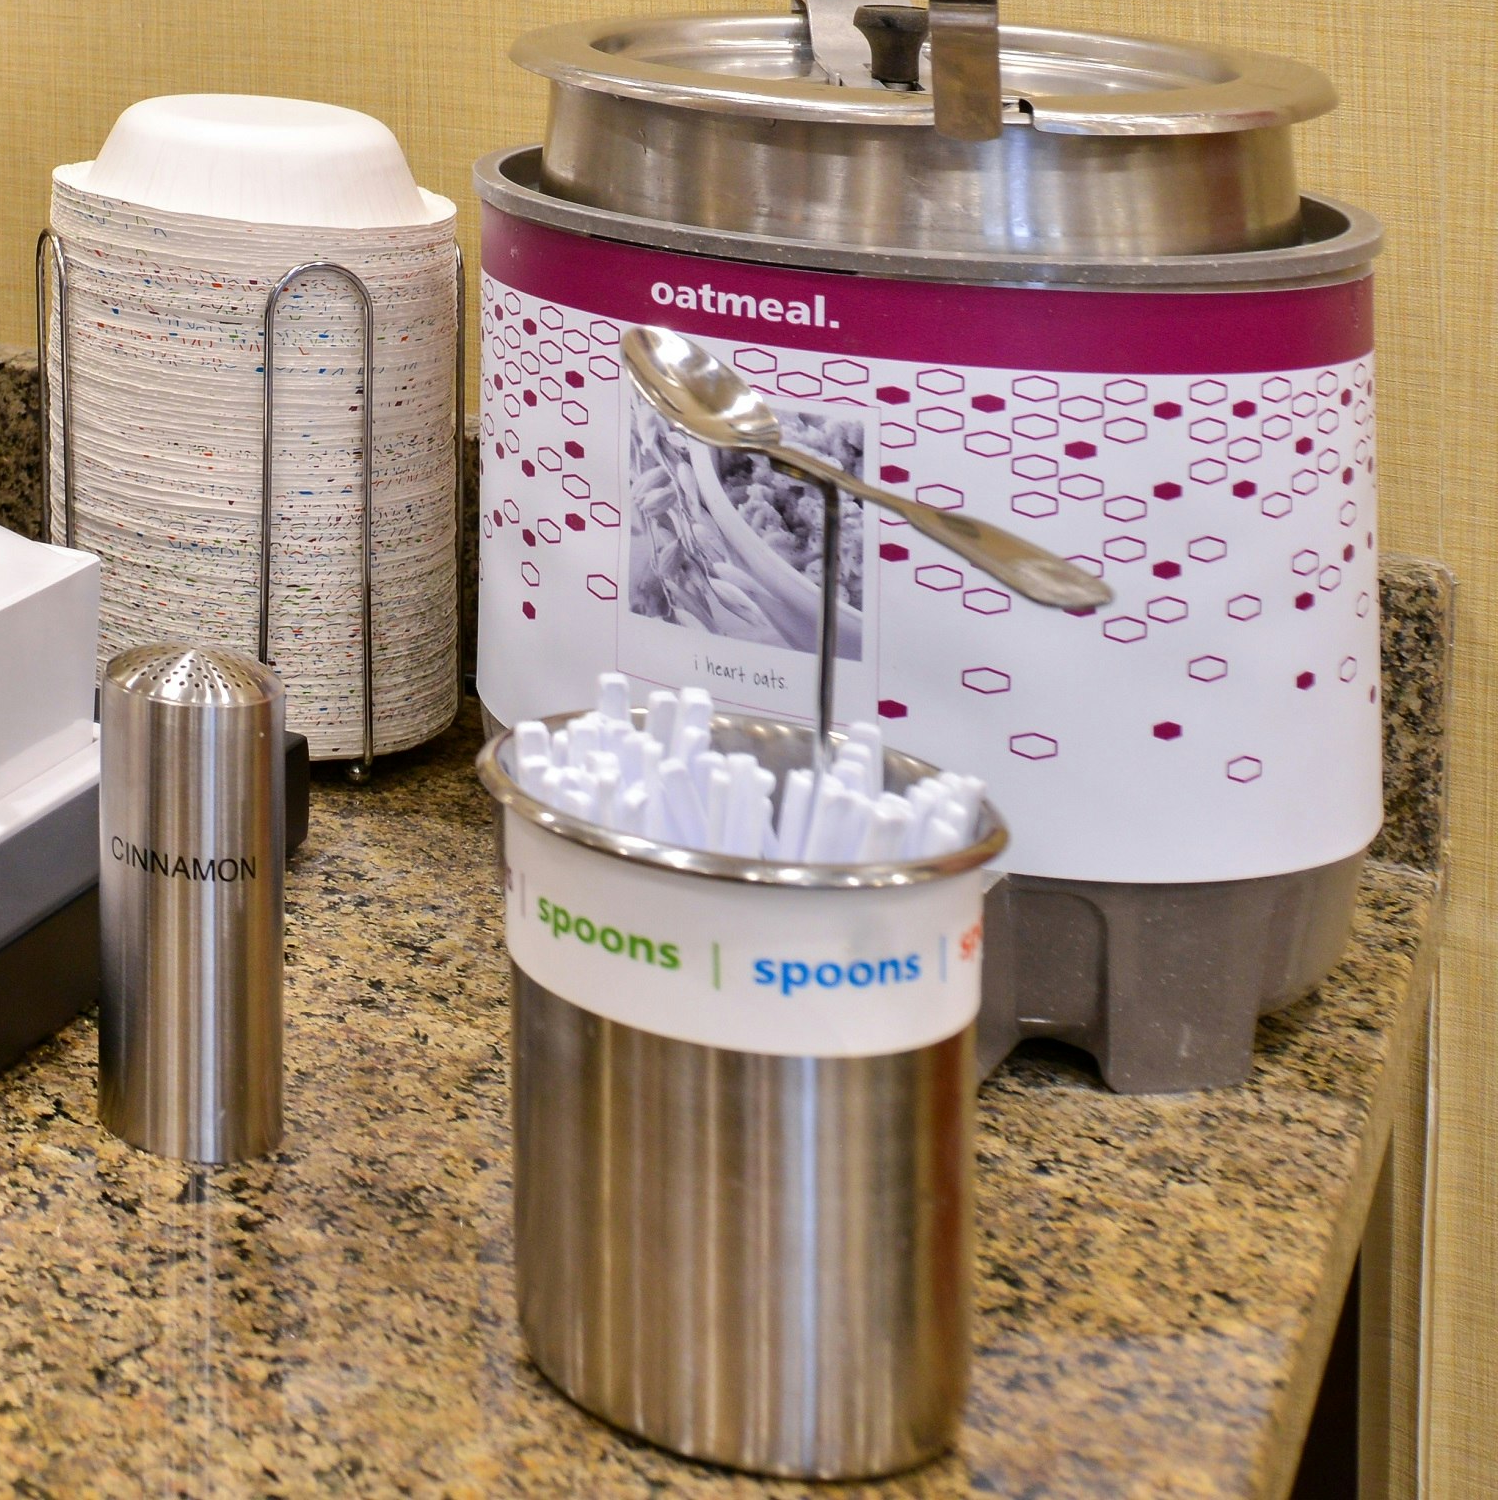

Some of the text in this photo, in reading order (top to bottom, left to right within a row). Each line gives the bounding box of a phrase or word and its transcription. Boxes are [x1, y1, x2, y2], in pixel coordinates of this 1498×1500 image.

[650, 280, 841, 329] oatmeal.
[706, 655, 746, 683] heart
[111, 835, 257, 883] CINNAMON
[538, 896, 922, 997] spoons spoons
